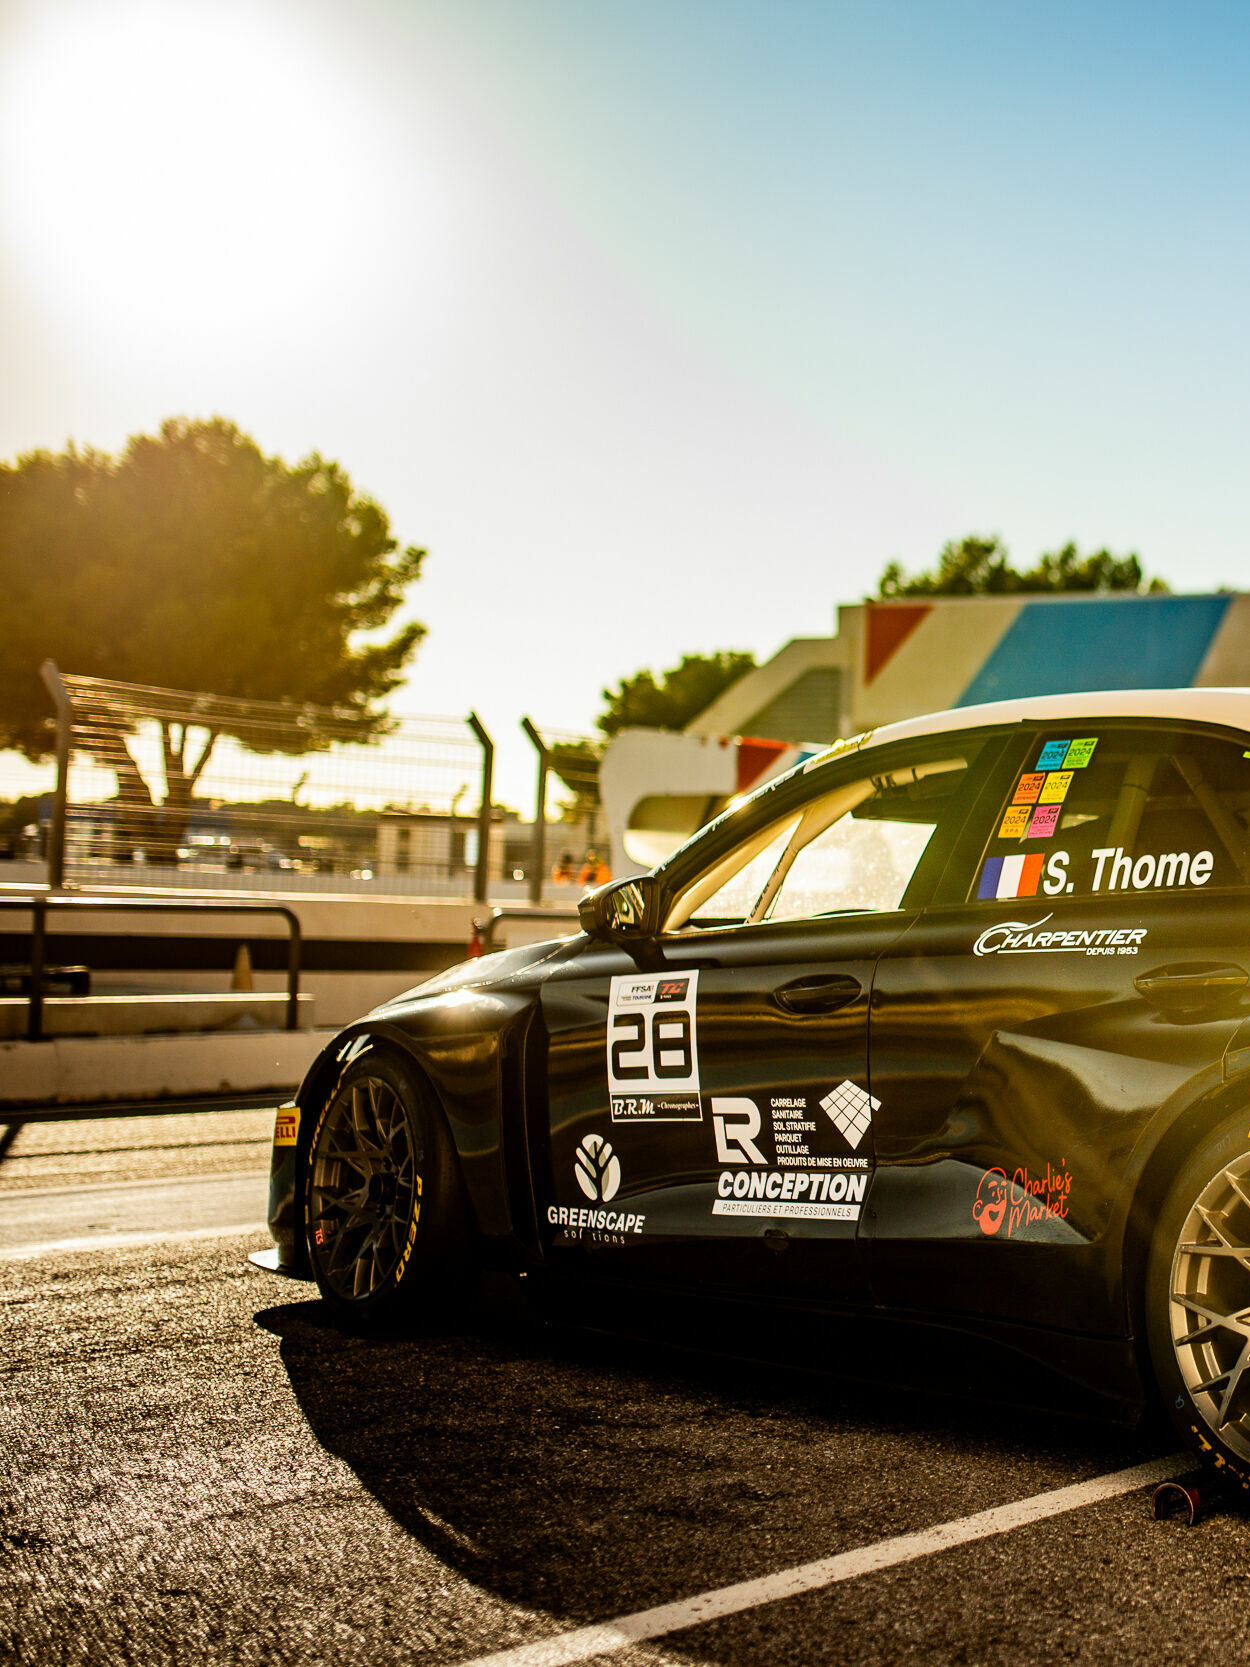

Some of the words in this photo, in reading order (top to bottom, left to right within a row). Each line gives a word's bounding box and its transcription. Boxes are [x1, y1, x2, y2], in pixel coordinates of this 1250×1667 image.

[1018, 782, 1041, 792] 2024
[1033, 814, 1057, 825] 2024
[1043, 850, 1074, 895] S.
[1091, 847, 1214, 891] Thome
[973, 920, 1147, 956] CHARPENTIER
[1086, 947, 1115, 956] DEPUIS
[1117, 947, 1138, 955] 1953
[612, 1010, 692, 1080] 28
[771, 1098, 806, 1108] CARRELAGE
[771, 1109, 803, 1120] SANITAIRE
[773, 1121, 785, 1131] SOL
[786, 1121, 816, 1132] STRATIFIE
[774, 1133, 802, 1143] PARQUET
[776, 1145, 809, 1155] OUTILLAGE
[777, 1156, 807, 1166] PRODUITS
[807, 1157, 816, 1167] DE
[817, 1157, 832, 1167] MISE
[833, 1158, 842, 1168] EN
[842, 1158, 868, 1168] OEUVRE
[717, 1171, 868, 1202] CONCEPTION
[1010, 1157, 1073, 1205] Charlie's
[722, 1203, 771, 1214] PARTICULIERS
[773, 1205, 782, 1214] ET
[784, 1205, 851, 1218] PROFESSIONNELS
[1008, 1191, 1069, 1238] Market
[547, 1205, 646, 1234] GREENSCAPE
